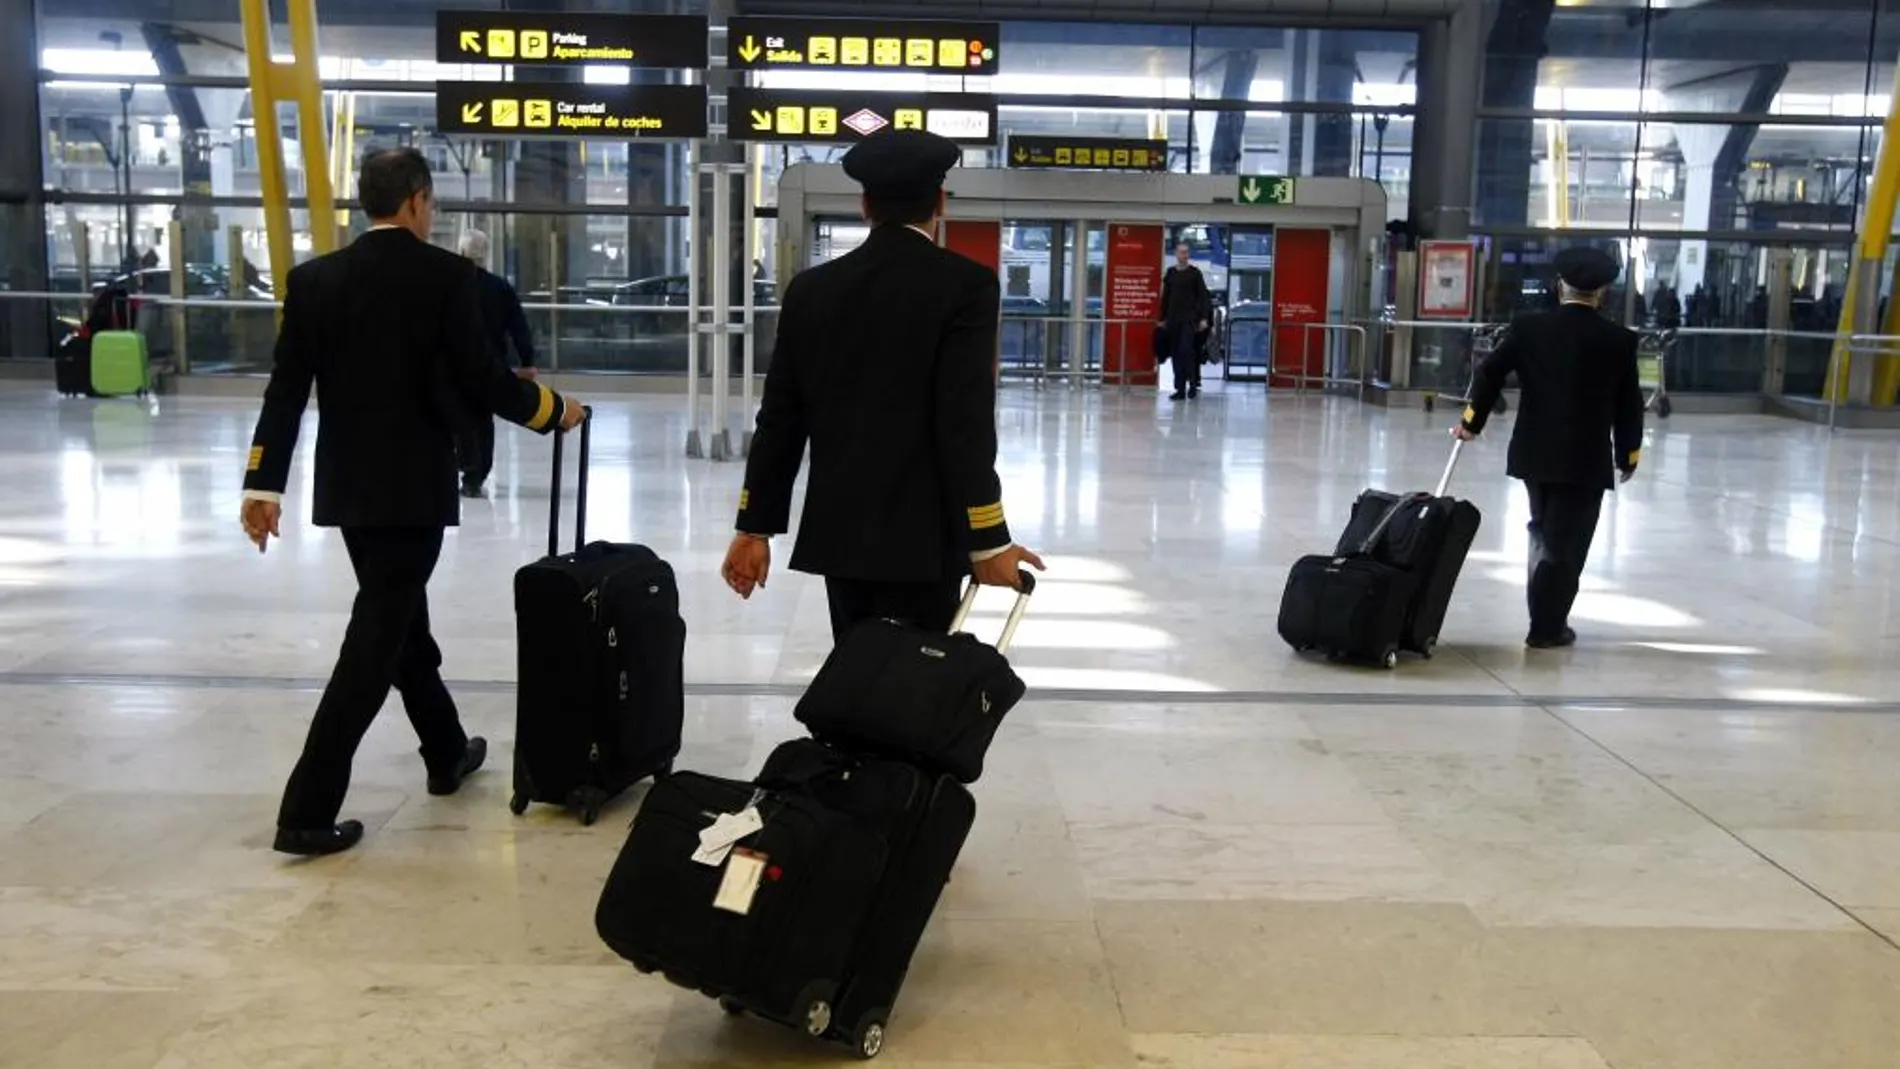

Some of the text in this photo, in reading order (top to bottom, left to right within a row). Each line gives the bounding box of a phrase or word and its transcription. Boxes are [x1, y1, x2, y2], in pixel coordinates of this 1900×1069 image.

[552, 33, 587, 46] Parking
[553, 46, 634, 59] Aparcamiento
[766, 50, 803, 62] Salida
[557, 102, 606, 113] Car rental
[557, 115, 662, 129] Alquiler de coches
